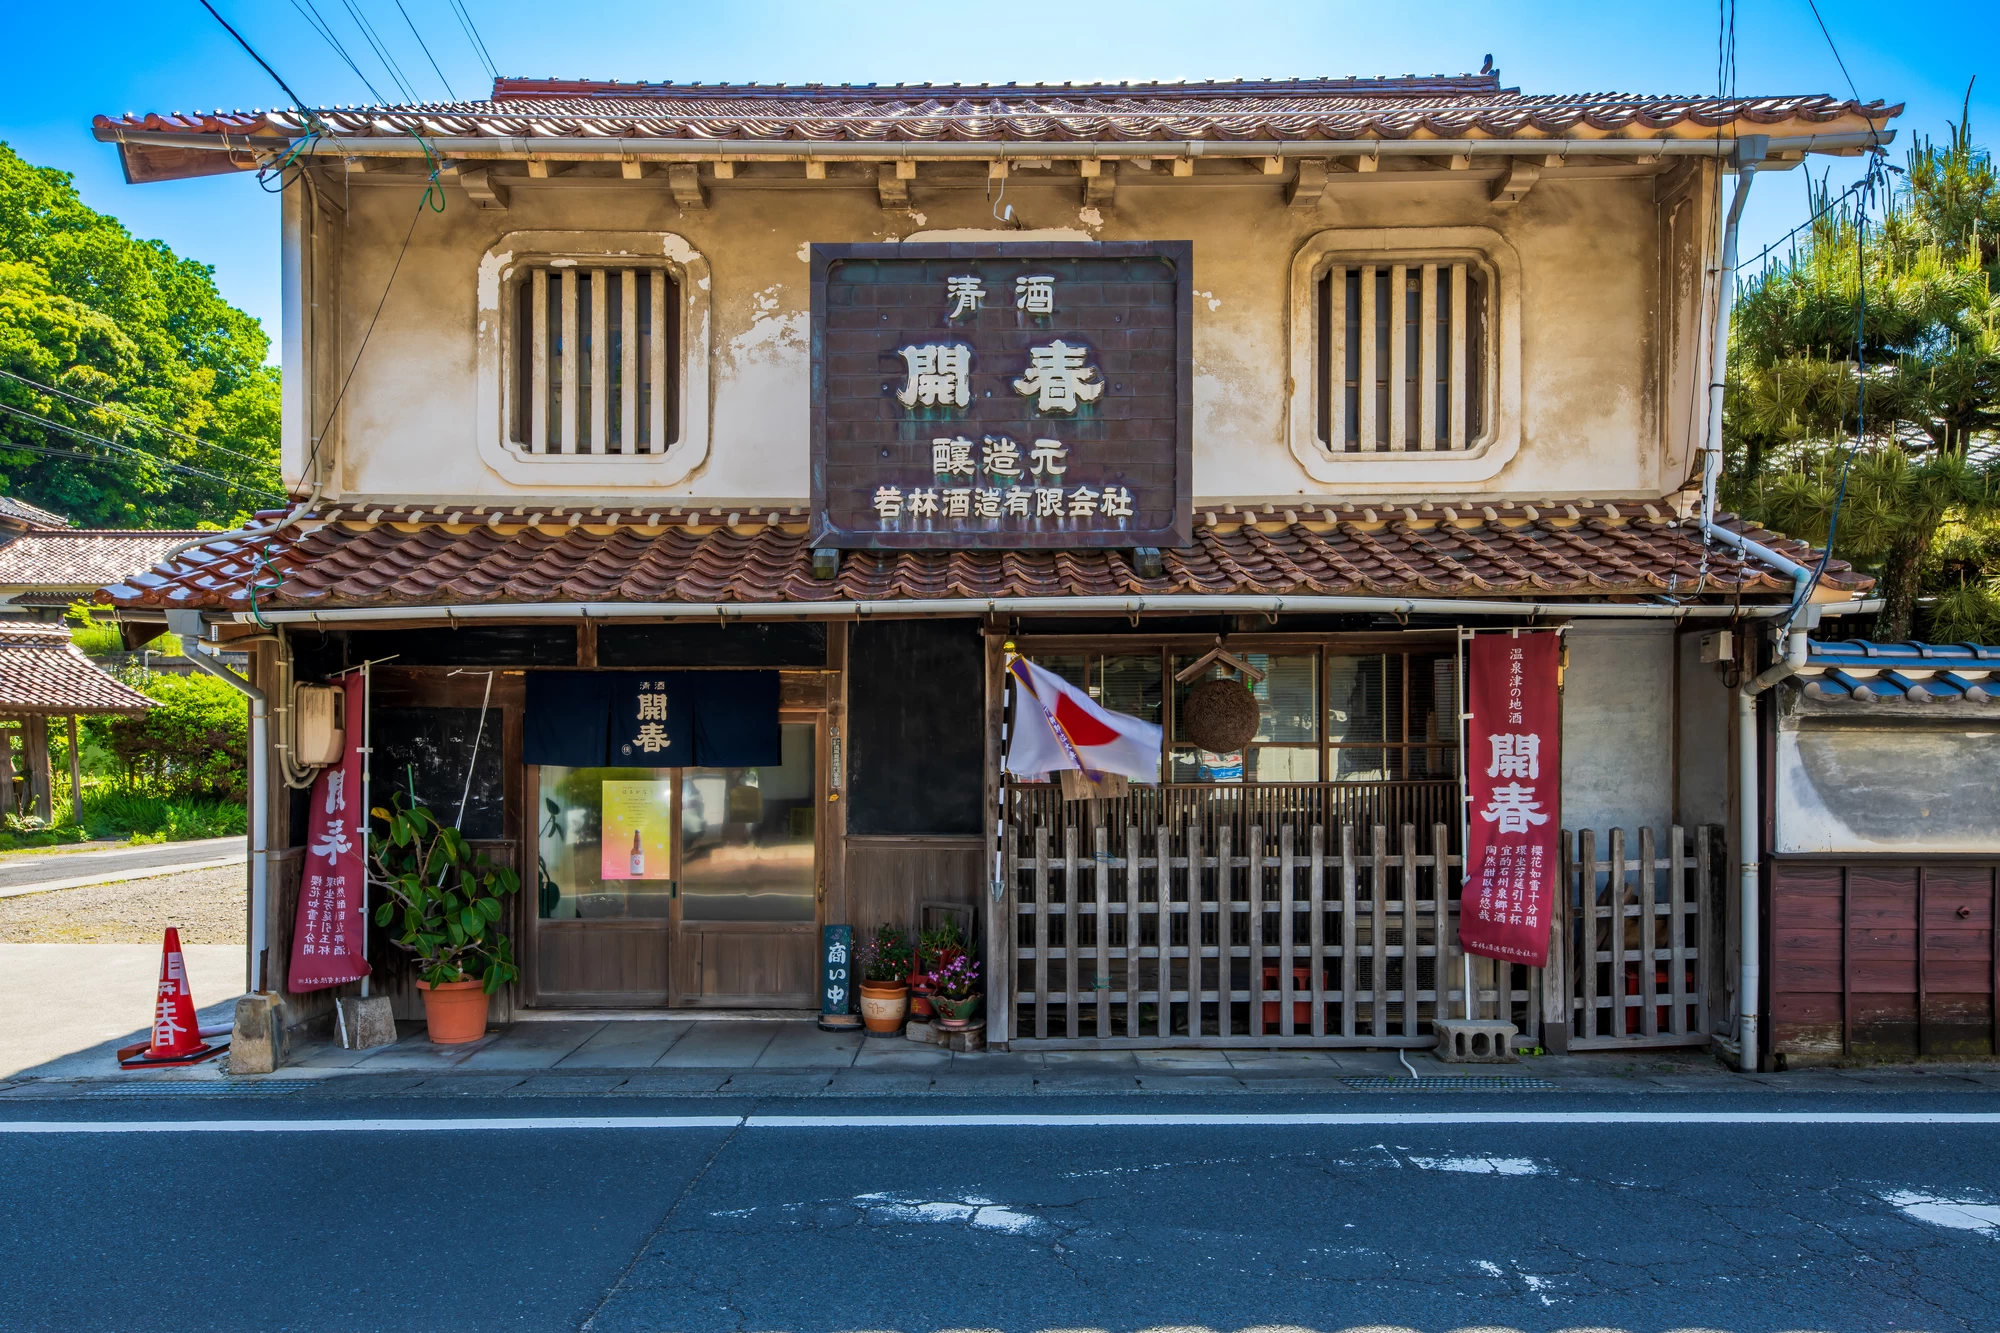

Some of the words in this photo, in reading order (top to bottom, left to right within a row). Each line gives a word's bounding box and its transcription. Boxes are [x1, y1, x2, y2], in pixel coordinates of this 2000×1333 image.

[947, 275, 1055, 320] 清酒
[896, 339, 1104, 413] 開春
[874, 486, 1133, 517] 若林酒造有限会社
[1509, 648, 1523, 724] 温泉津の地酒
[632, 693, 671, 753] 開春
[1481, 733, 1551, 834] 開春
[827, 942, 847, 1004] 商い中
